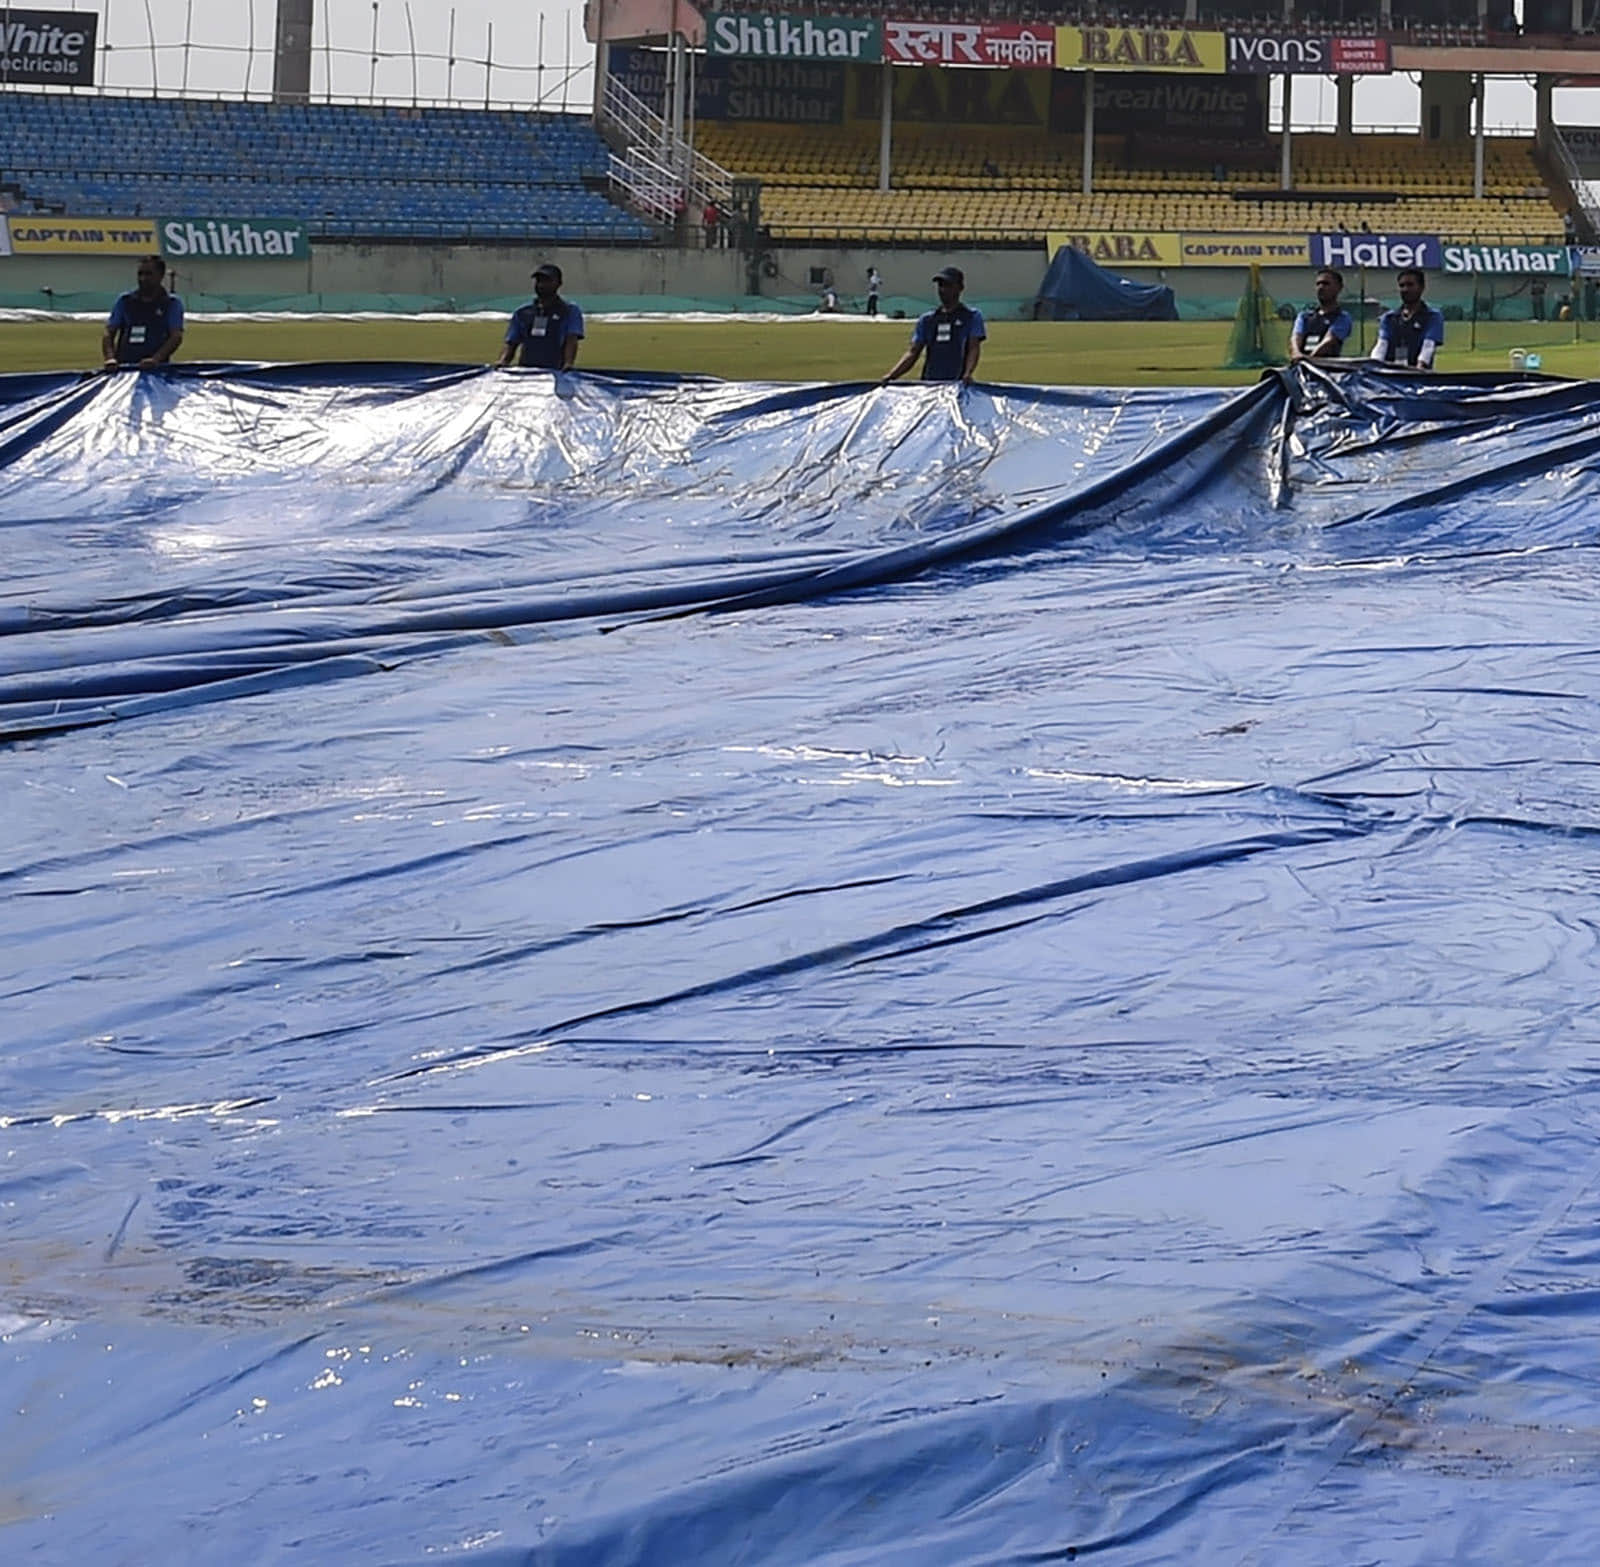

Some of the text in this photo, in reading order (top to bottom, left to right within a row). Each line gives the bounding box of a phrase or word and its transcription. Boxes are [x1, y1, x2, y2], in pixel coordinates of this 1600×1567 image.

[714, 16, 868, 57] Shikhar
[985, 31, 1053, 64] नमकीन
[1079, 26, 1204, 68] BABA
[13, 228, 152, 244] CAPTAIN TMT
[164, 222, 299, 256] Shikhar
[1184, 244, 1306, 257] CAPTAIN TMT
[1323, 236, 1427, 268] Haier
[1445, 246, 1562, 273] Shikhar
